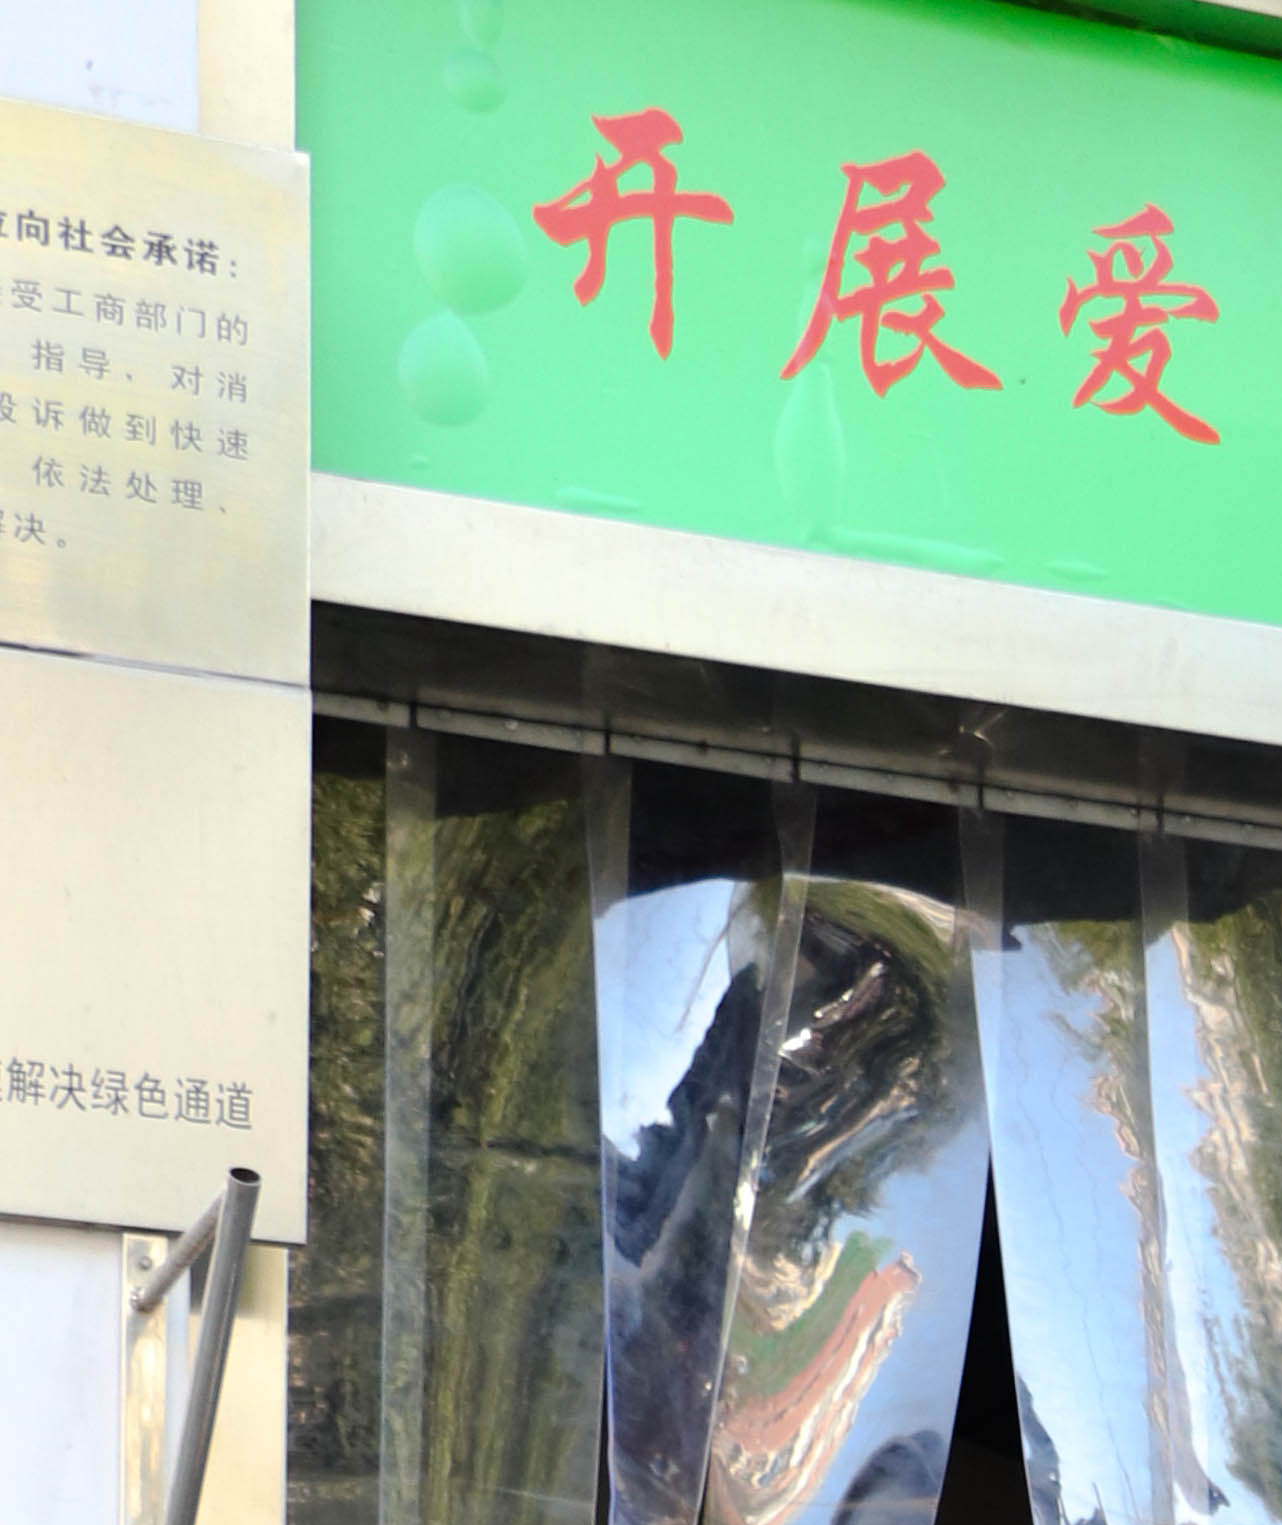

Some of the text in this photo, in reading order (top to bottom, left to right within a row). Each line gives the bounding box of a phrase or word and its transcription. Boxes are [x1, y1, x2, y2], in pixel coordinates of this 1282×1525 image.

[0, 208, 237, 279] 向社会承诺：
[0, 277, 249, 347] 受工商部门的
[0, 508, 68, 550] 决。
[0, 1055, 254, 1131] 解决绿色通道
